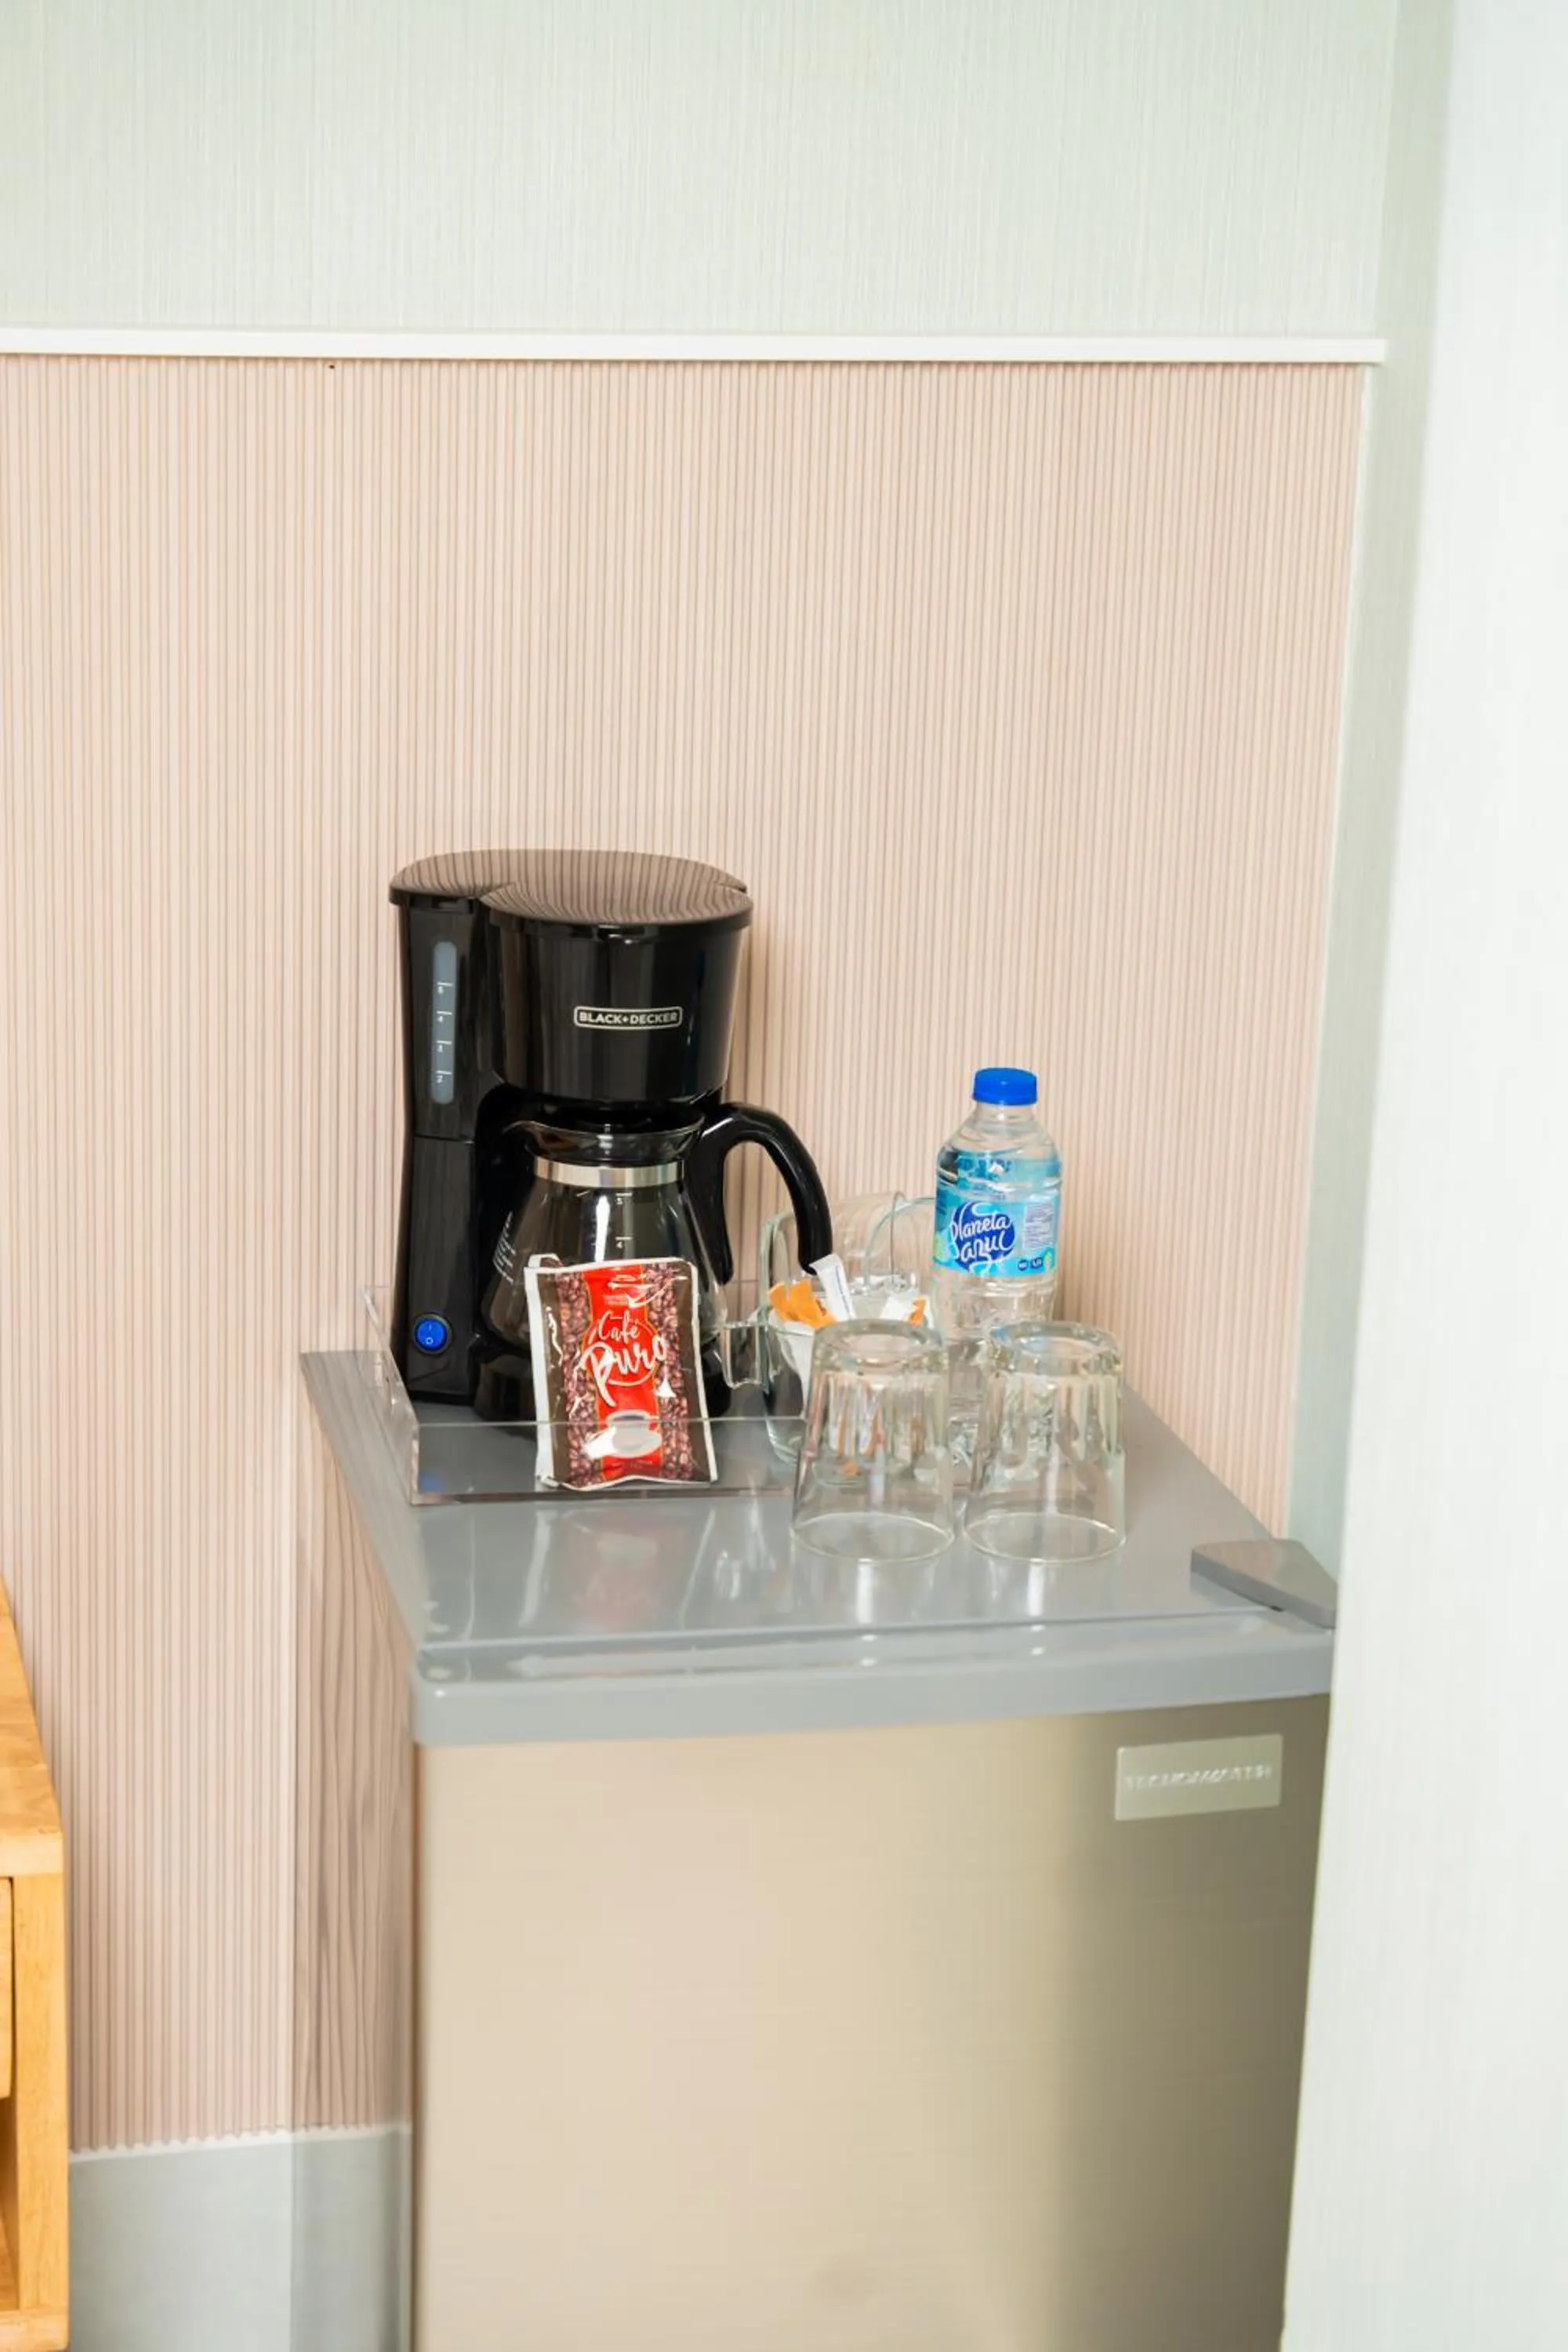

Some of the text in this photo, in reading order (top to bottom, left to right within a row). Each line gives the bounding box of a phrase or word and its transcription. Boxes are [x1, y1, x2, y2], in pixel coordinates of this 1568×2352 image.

[579, 1011, 678, 1025] BLACK+DECKER
[949, 1202, 1011, 1245] Planeta
[579, 1341, 666, 1407] Puro
